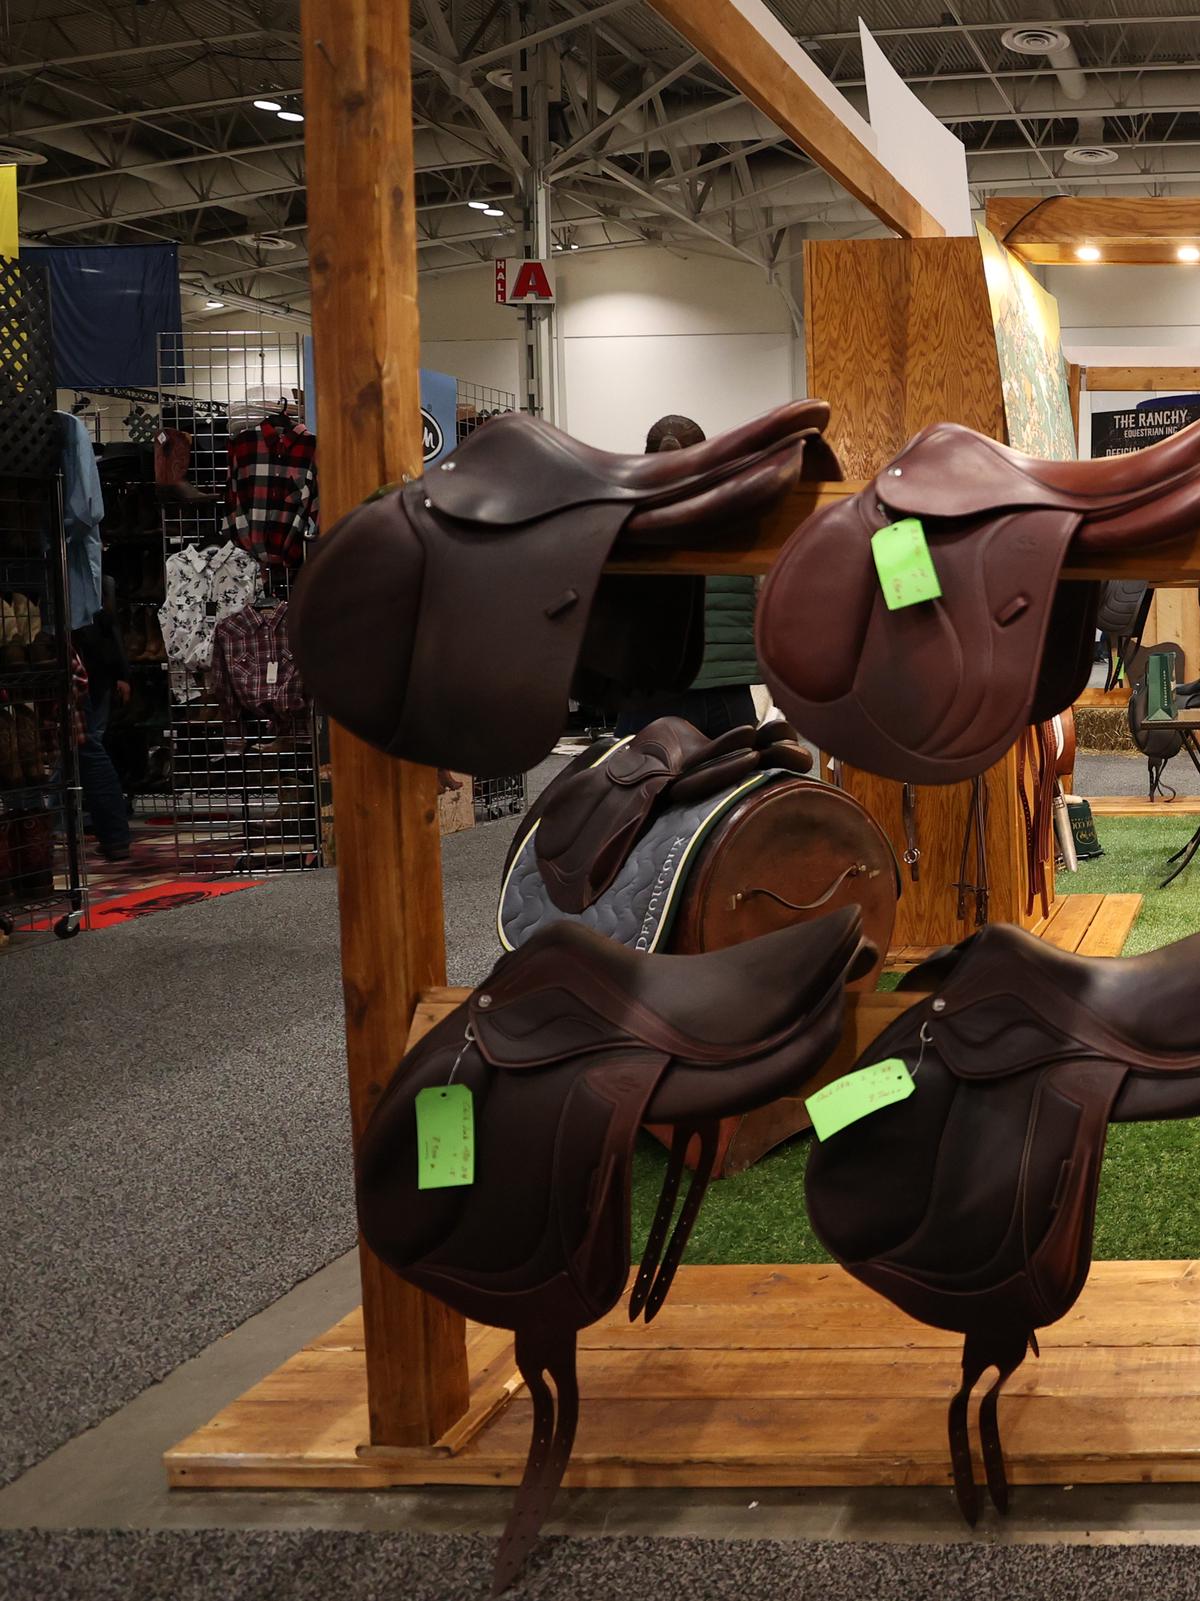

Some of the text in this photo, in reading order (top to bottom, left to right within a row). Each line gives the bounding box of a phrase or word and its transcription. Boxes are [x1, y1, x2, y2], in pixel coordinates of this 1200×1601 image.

[496, 260, 505, 302] HALL
[511, 262, 553, 299] A
[1113, 409, 1188, 429] THE RANCHY
[1124, 428, 1164, 438] EQUESTRIAN
[635, 837, 686, 951] DEVOUCOUX
